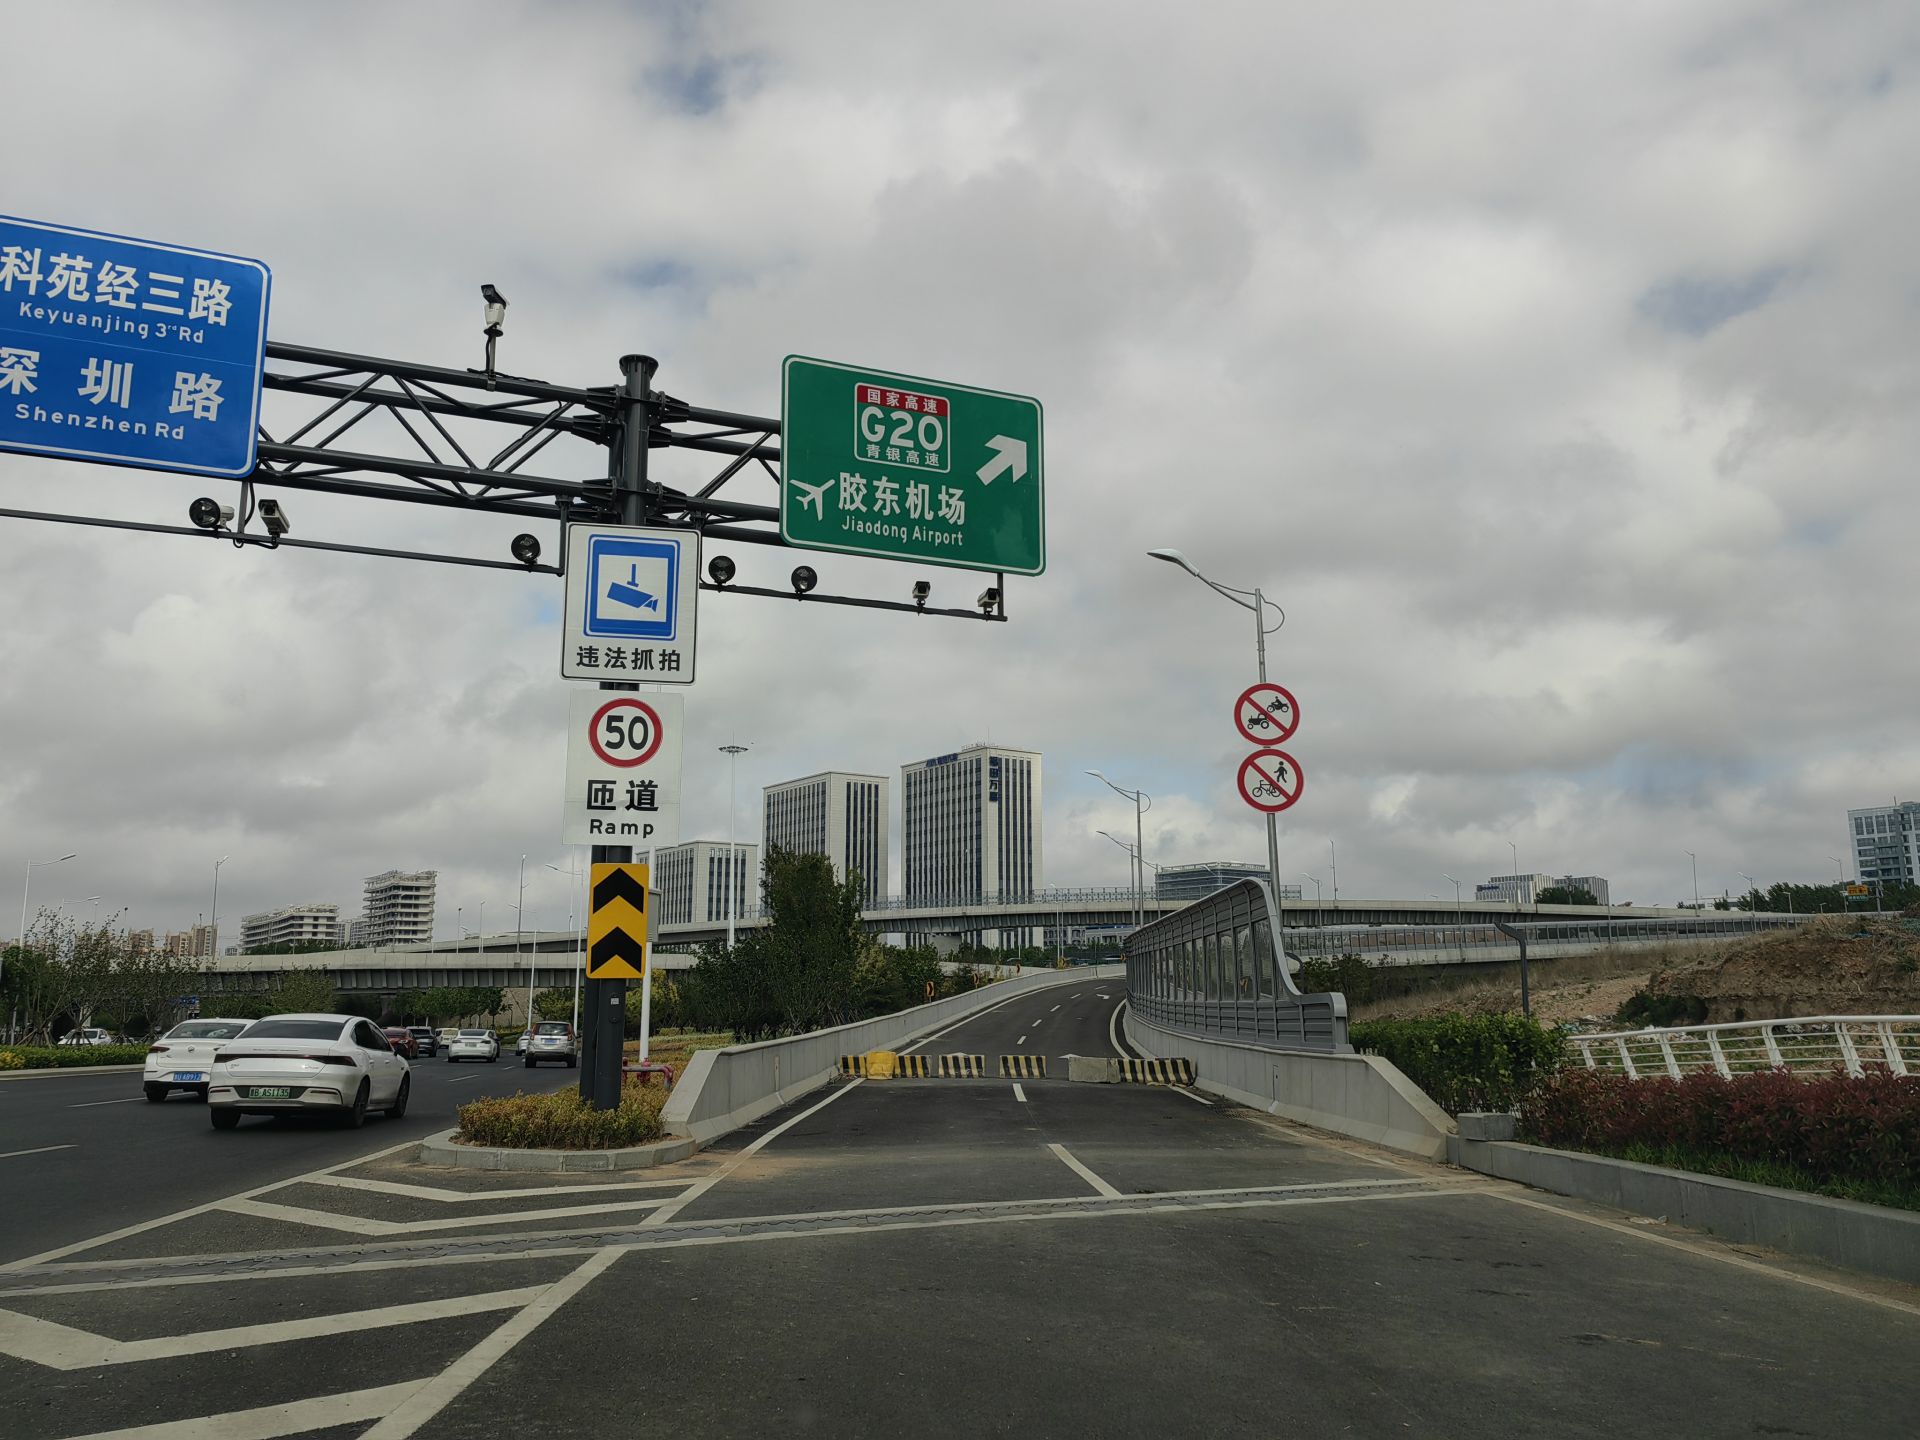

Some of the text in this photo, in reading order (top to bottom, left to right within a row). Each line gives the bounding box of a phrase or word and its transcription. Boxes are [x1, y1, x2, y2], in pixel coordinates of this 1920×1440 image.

[0, 246, 232, 326] 科苑经三路
[19, 301, 149, 338] Keyuanjing
[179, 326, 204, 343] Rd
[0, 347, 224, 421] 深圳路
[867, 388, 938, 414] 国家高速
[15, 403, 184, 440] Shenzhen Rd
[861, 406, 943, 451] G20
[866, 444, 940, 467] 青银高速
[838, 472, 966, 526] 胶东机场
[842, 516, 963, 547] Jiaodong Airport
[576, 645, 681, 672] 违法抓拍
[604, 714, 649, 750] 50
[586, 779, 660, 812] 匝道
[589, 819, 655, 839] Ramp
